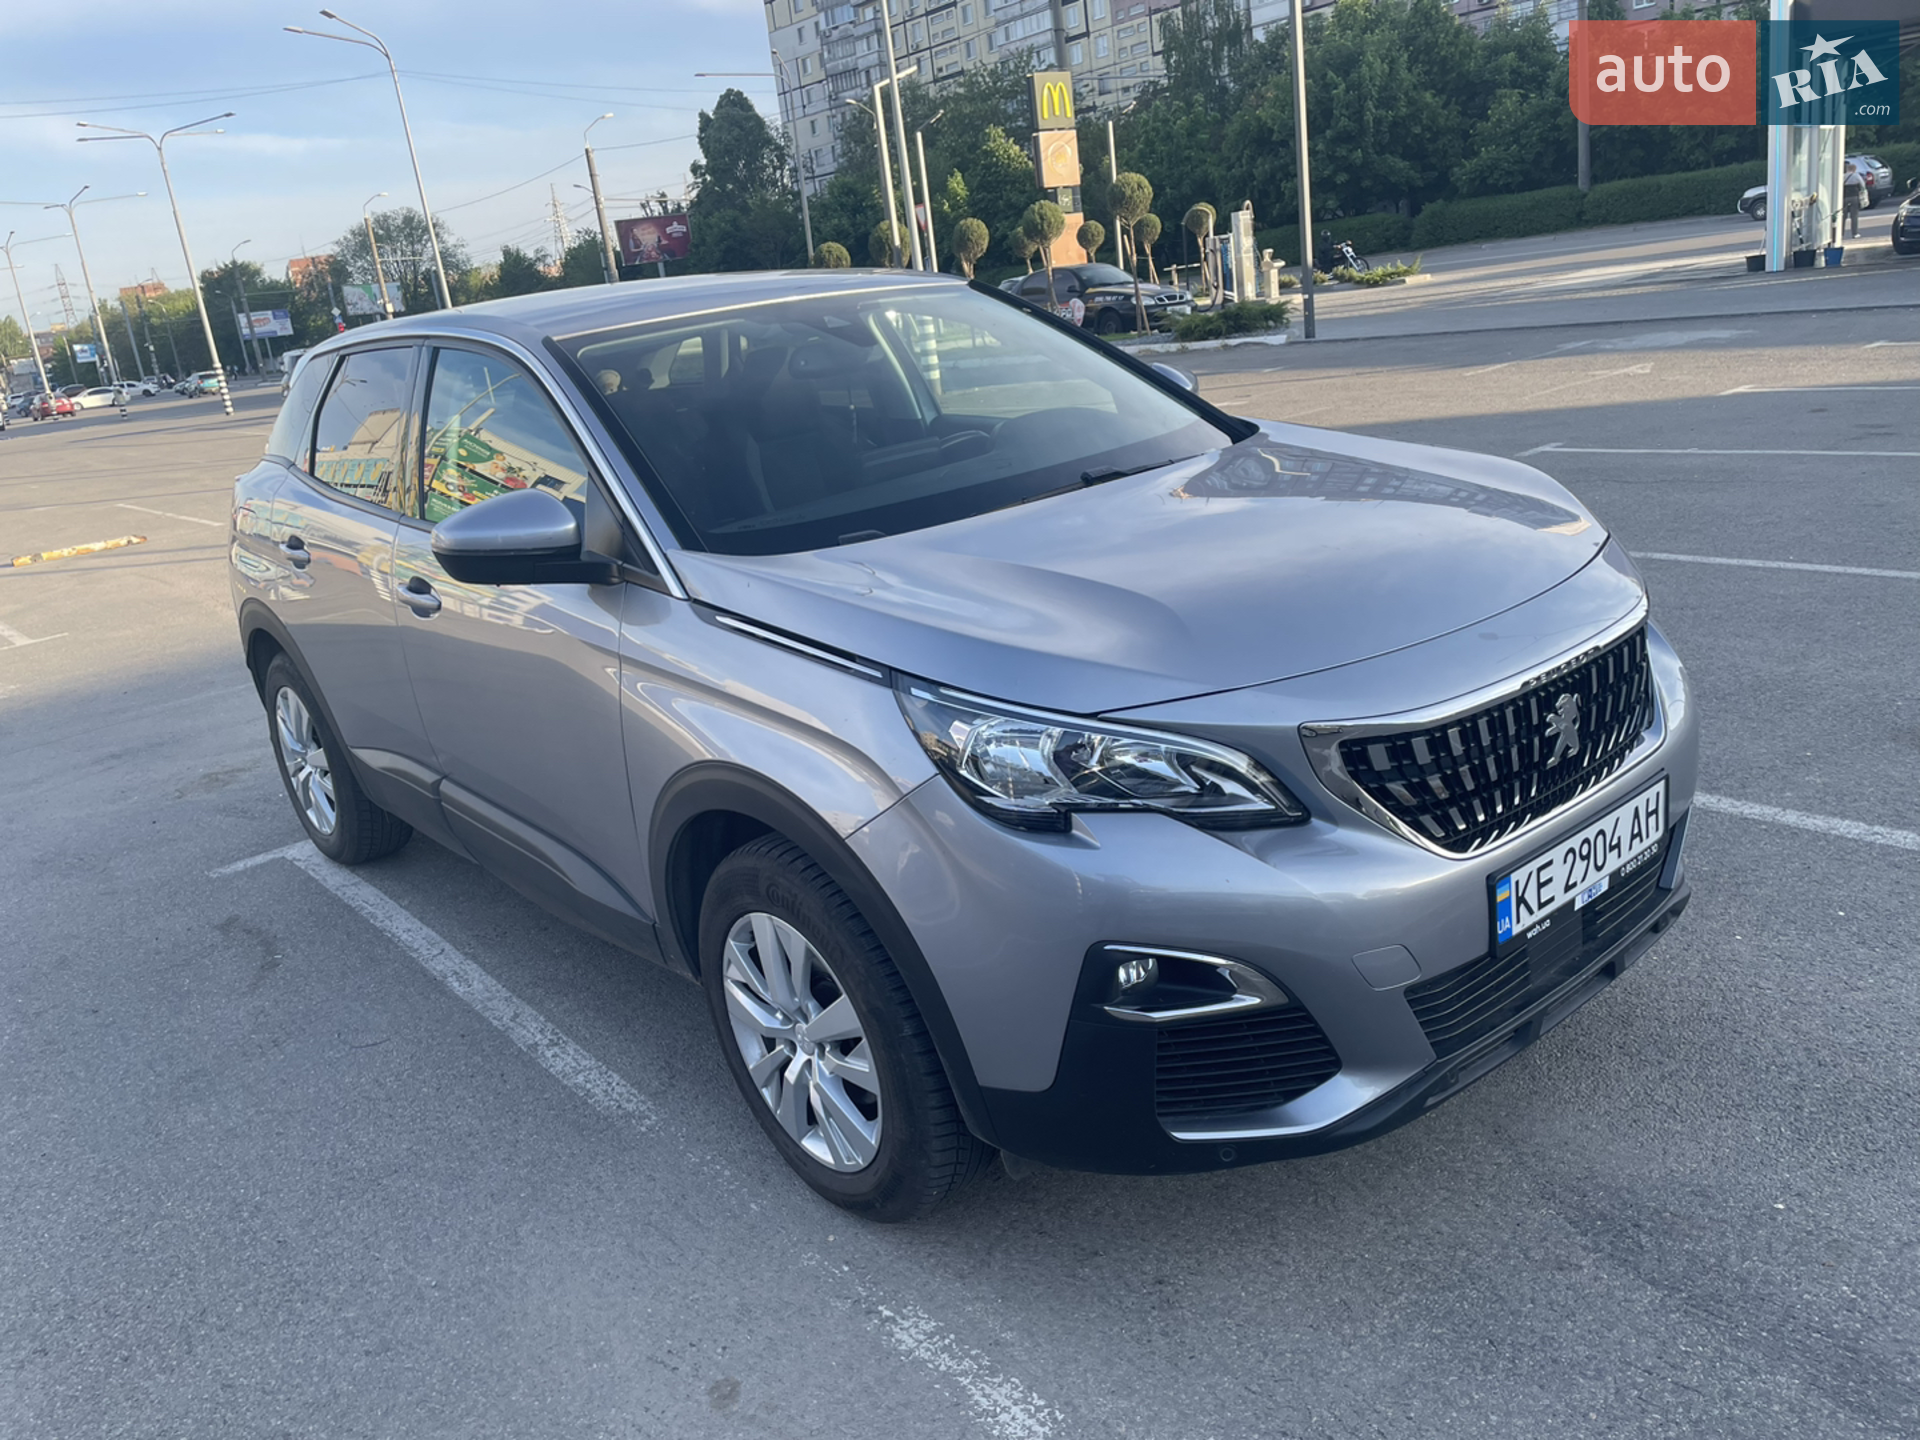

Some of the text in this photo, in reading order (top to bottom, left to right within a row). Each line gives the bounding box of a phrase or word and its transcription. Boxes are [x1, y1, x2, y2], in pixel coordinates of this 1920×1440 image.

[1515, 791, 1660, 926] KE 2904 AH
[1496, 916, 1511, 934] UA
